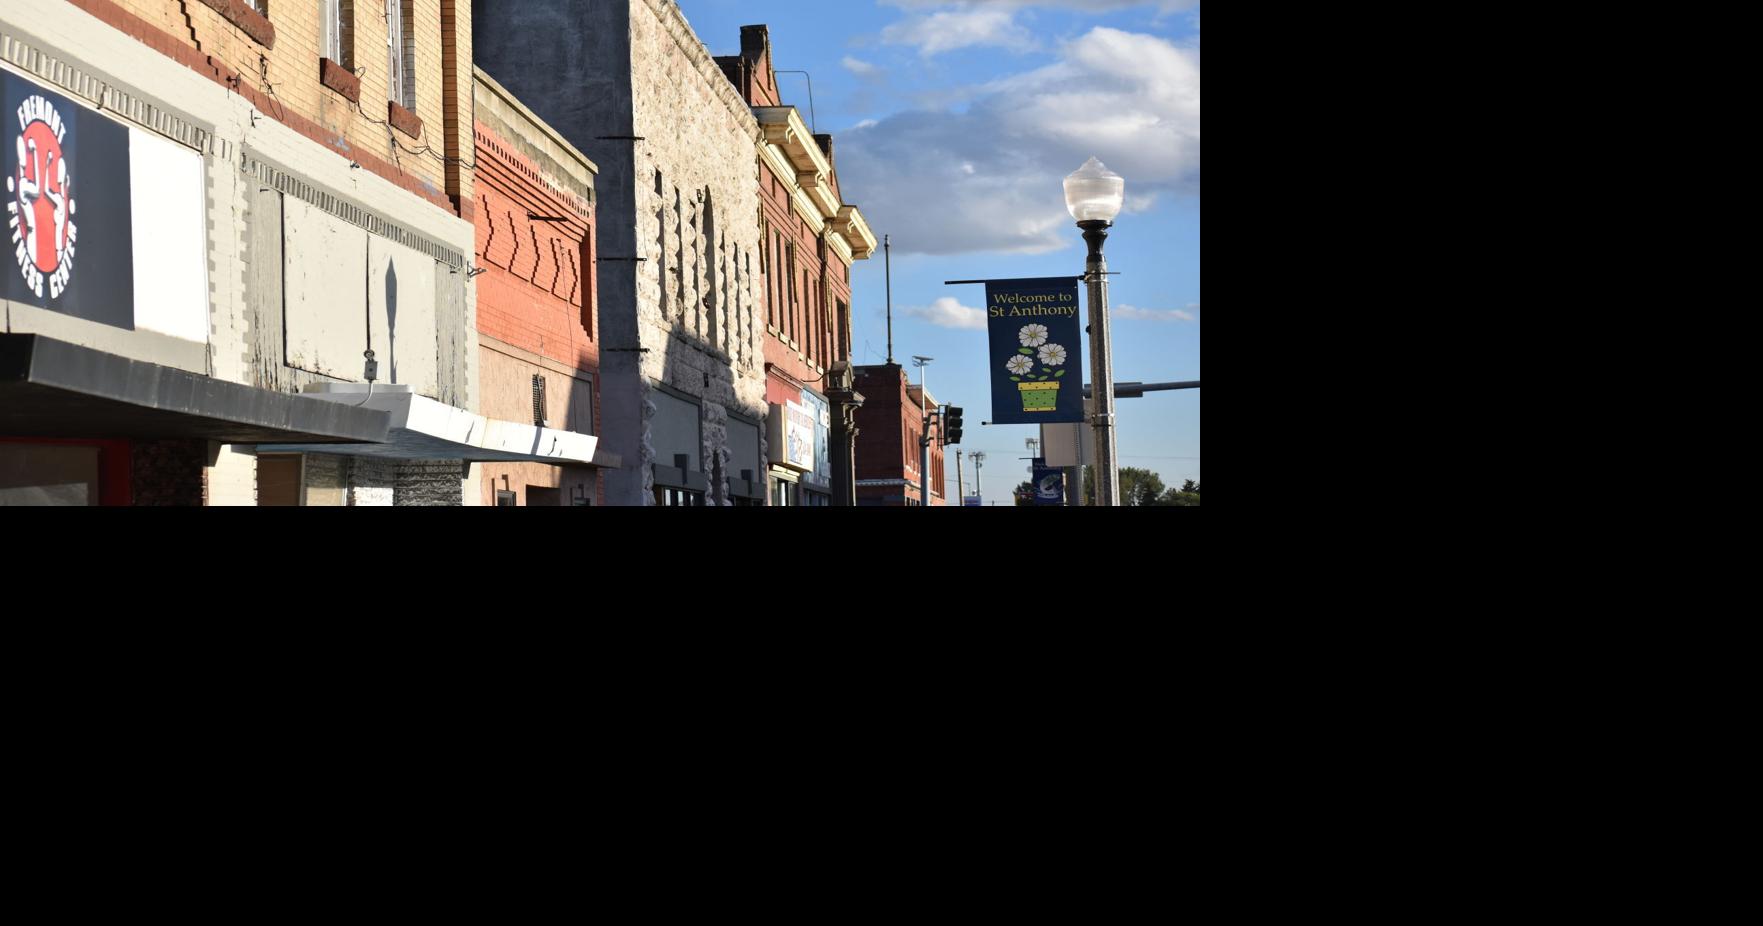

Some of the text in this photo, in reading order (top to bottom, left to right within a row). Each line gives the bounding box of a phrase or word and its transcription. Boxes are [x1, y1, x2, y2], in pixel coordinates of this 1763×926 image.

[17, 95, 67, 144] FREMONT
[8, 201, 77, 299] FITNESS CENTER
[990, 304, 1076, 318] St Anthony
[994, 293, 1072, 304] Welcome to
